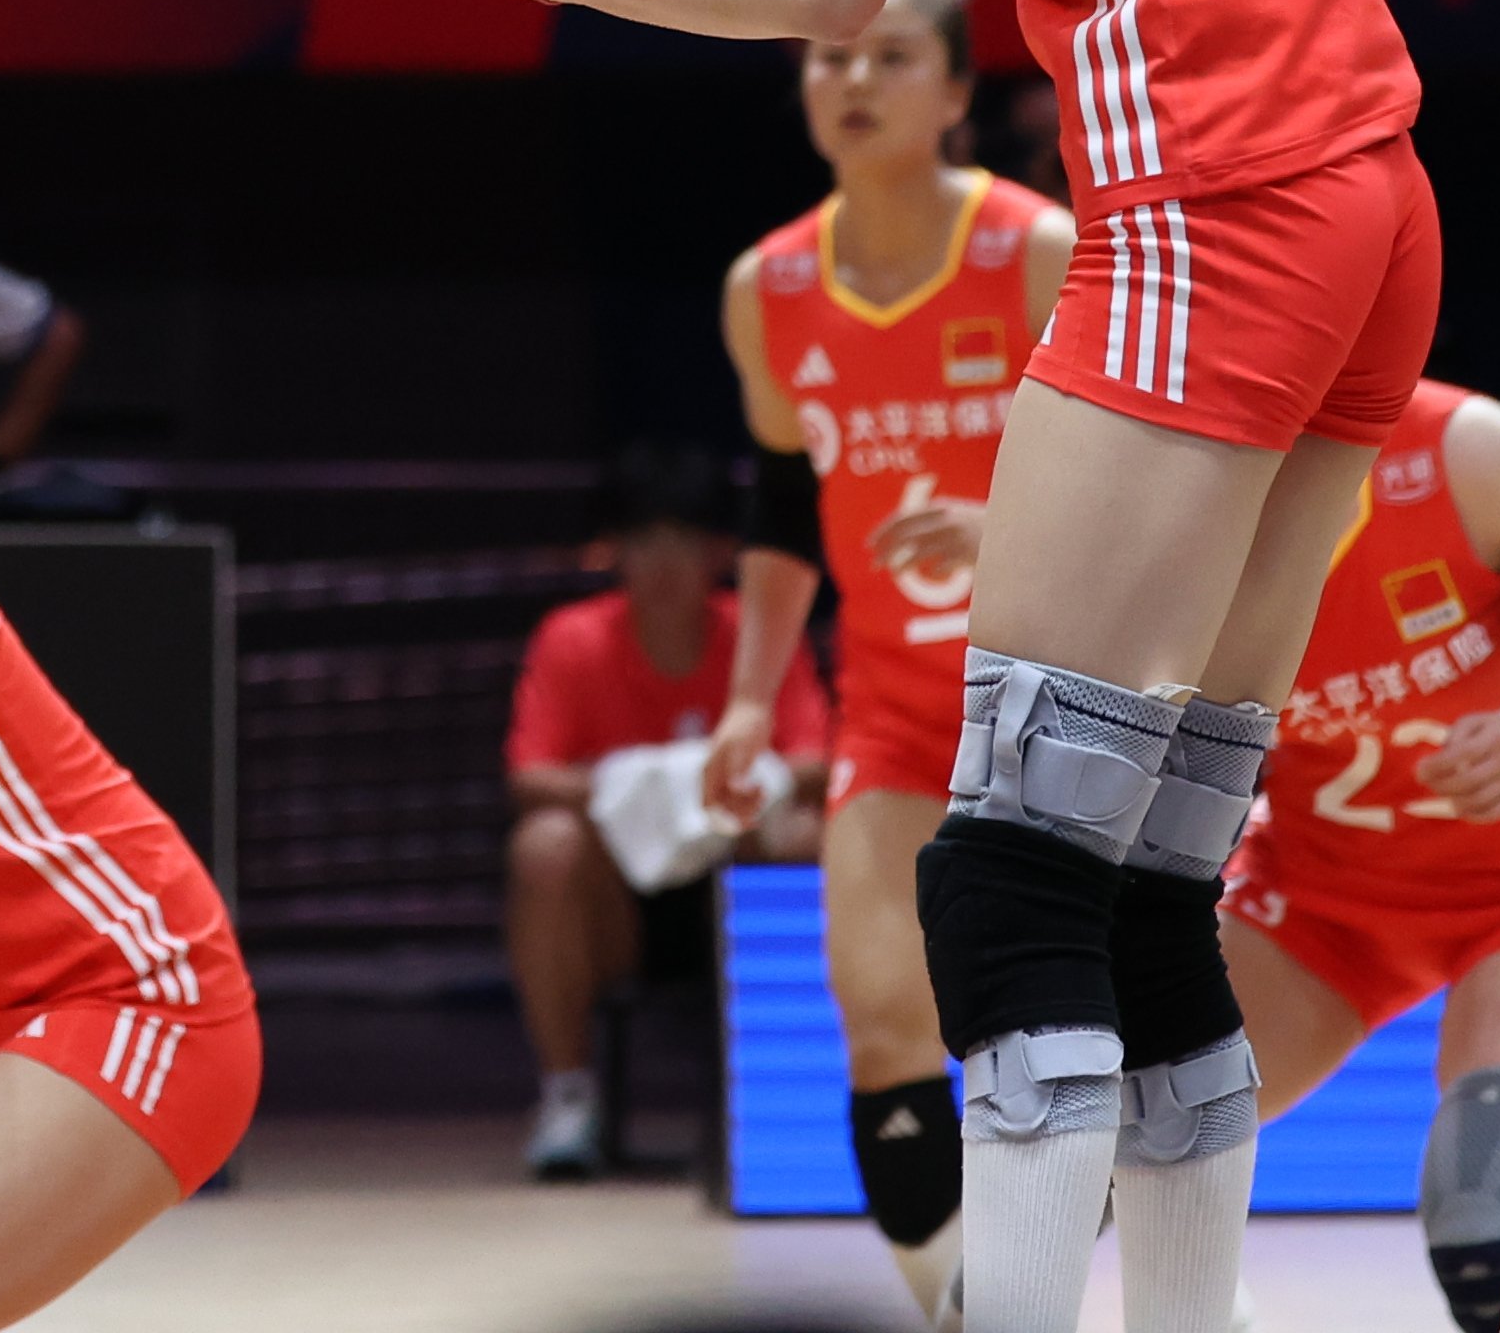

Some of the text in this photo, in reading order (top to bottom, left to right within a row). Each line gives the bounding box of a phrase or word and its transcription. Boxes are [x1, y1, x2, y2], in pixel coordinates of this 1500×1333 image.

[1286, 623, 1496, 727] 太平洋保险
